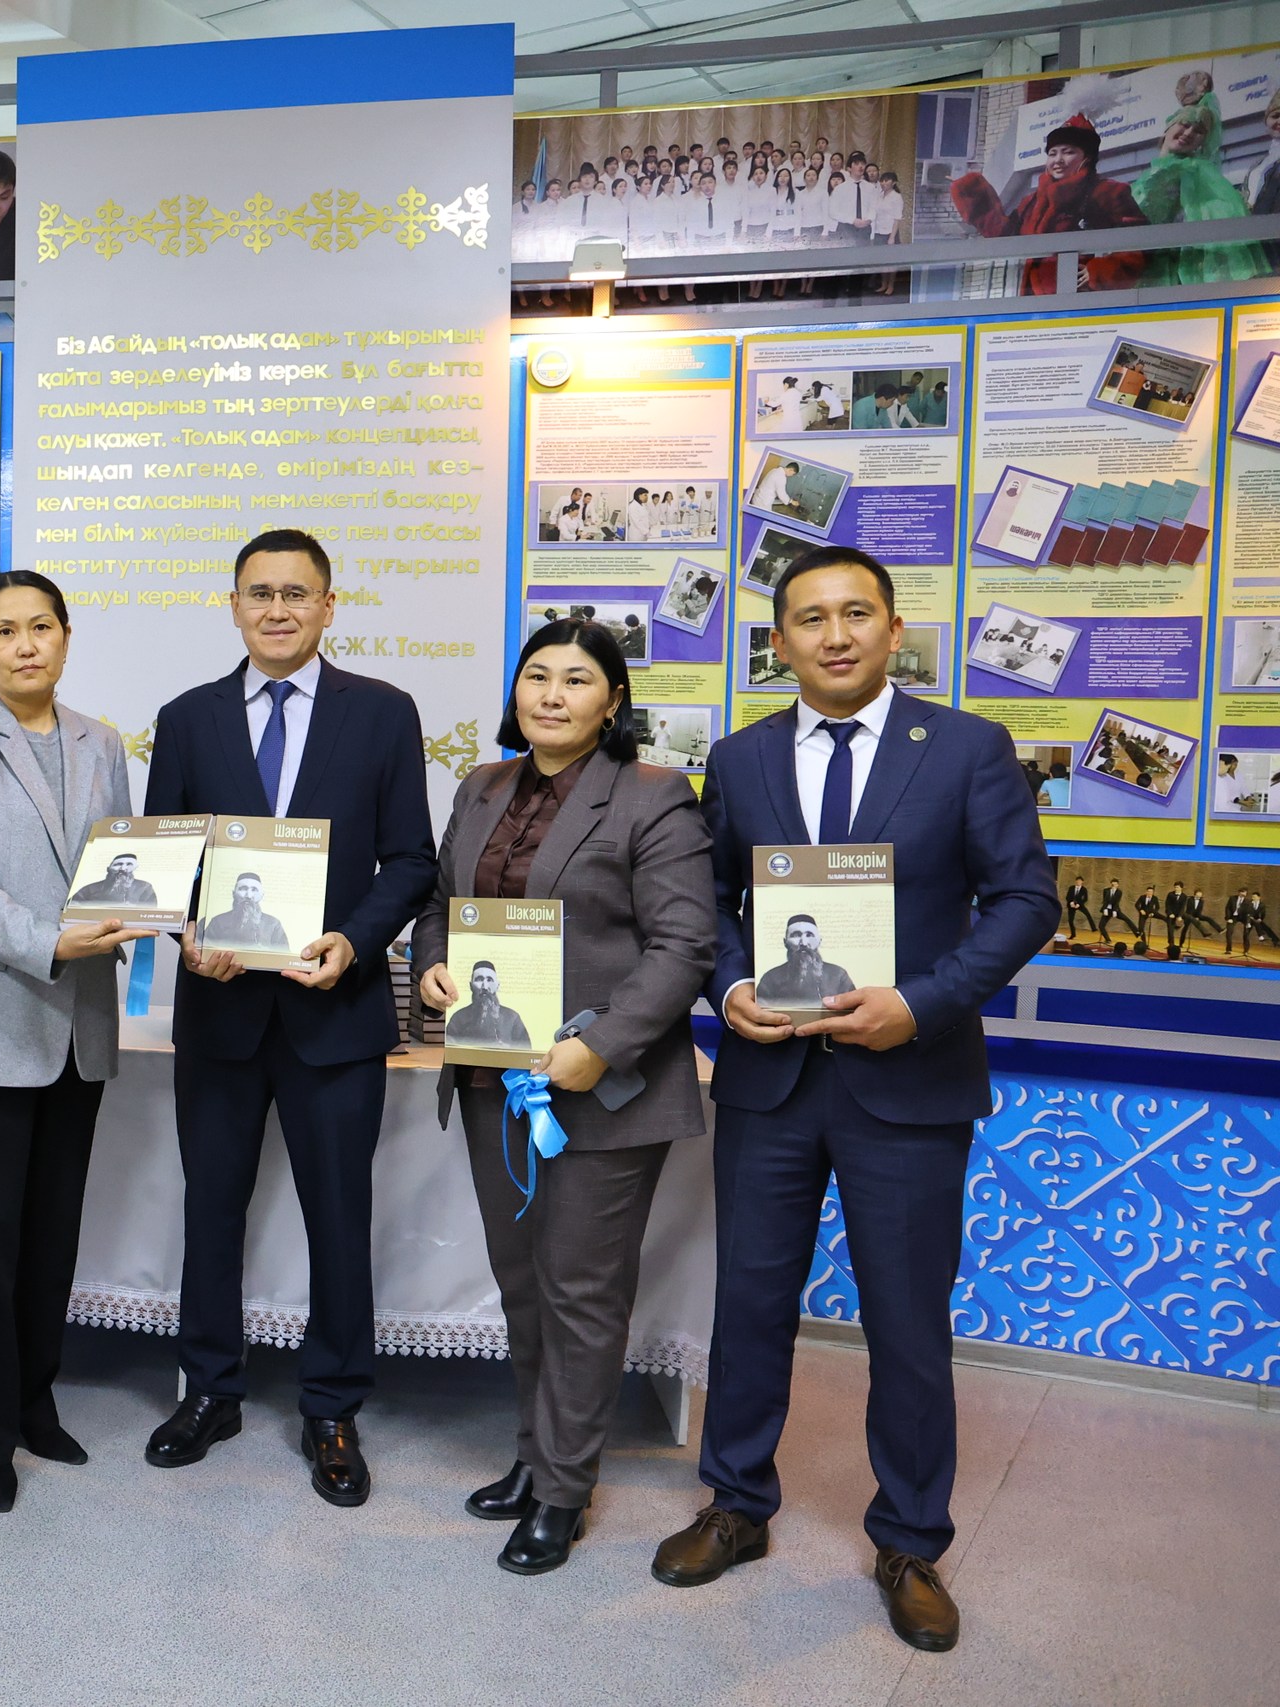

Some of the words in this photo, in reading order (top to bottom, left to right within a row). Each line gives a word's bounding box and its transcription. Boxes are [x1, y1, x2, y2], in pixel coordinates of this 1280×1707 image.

[57, 336, 85, 355] Біз
[87, 334, 187, 355] Абайдың
[189, 333, 268, 350] «толық
[270, 331, 340, 350] адам»
[344, 328, 486, 351] тұжырымын
[37, 368, 102, 390] қайта
[109, 361, 252, 389] зерделеуіміз
[259, 364, 333, 386] керек.
[341, 361, 380, 384] Бұл
[387, 359, 484, 378] бағытта
[38, 399, 207, 421] ғалымдарымыз
[212, 398, 255, 416] тың
[260, 391, 412, 418] зерттеулерді
[417, 394, 484, 413] қолға
[37, 434, 92, 455] алуы
[94, 432, 167, 451] қажет.
[171, 428, 248, 447] «Толық
[251, 428, 321, 447] адам»
[325, 426, 482, 446] концепциясы,
[37, 463, 133, 483] шындап
[144, 462, 265, 480] келгенде,
[277, 457, 417, 481] өміріміздің
[36, 495, 110, 512] келген
[113, 494, 242, 512] саласының
[250, 488, 379, 509] мемлекетті
[383, 488, 482, 514] басқару
[36, 527, 78, 543] мен
[83, 522, 134, 543] білім
[346, 525, 388, 541] пен
[394, 522, 481, 541] отбасы
[355, 557, 481, 579] тұғырына
[62, 590, 129, 611] налуы
[137, 590, 203, 611] керек
[205, 590, 232, 608] де
